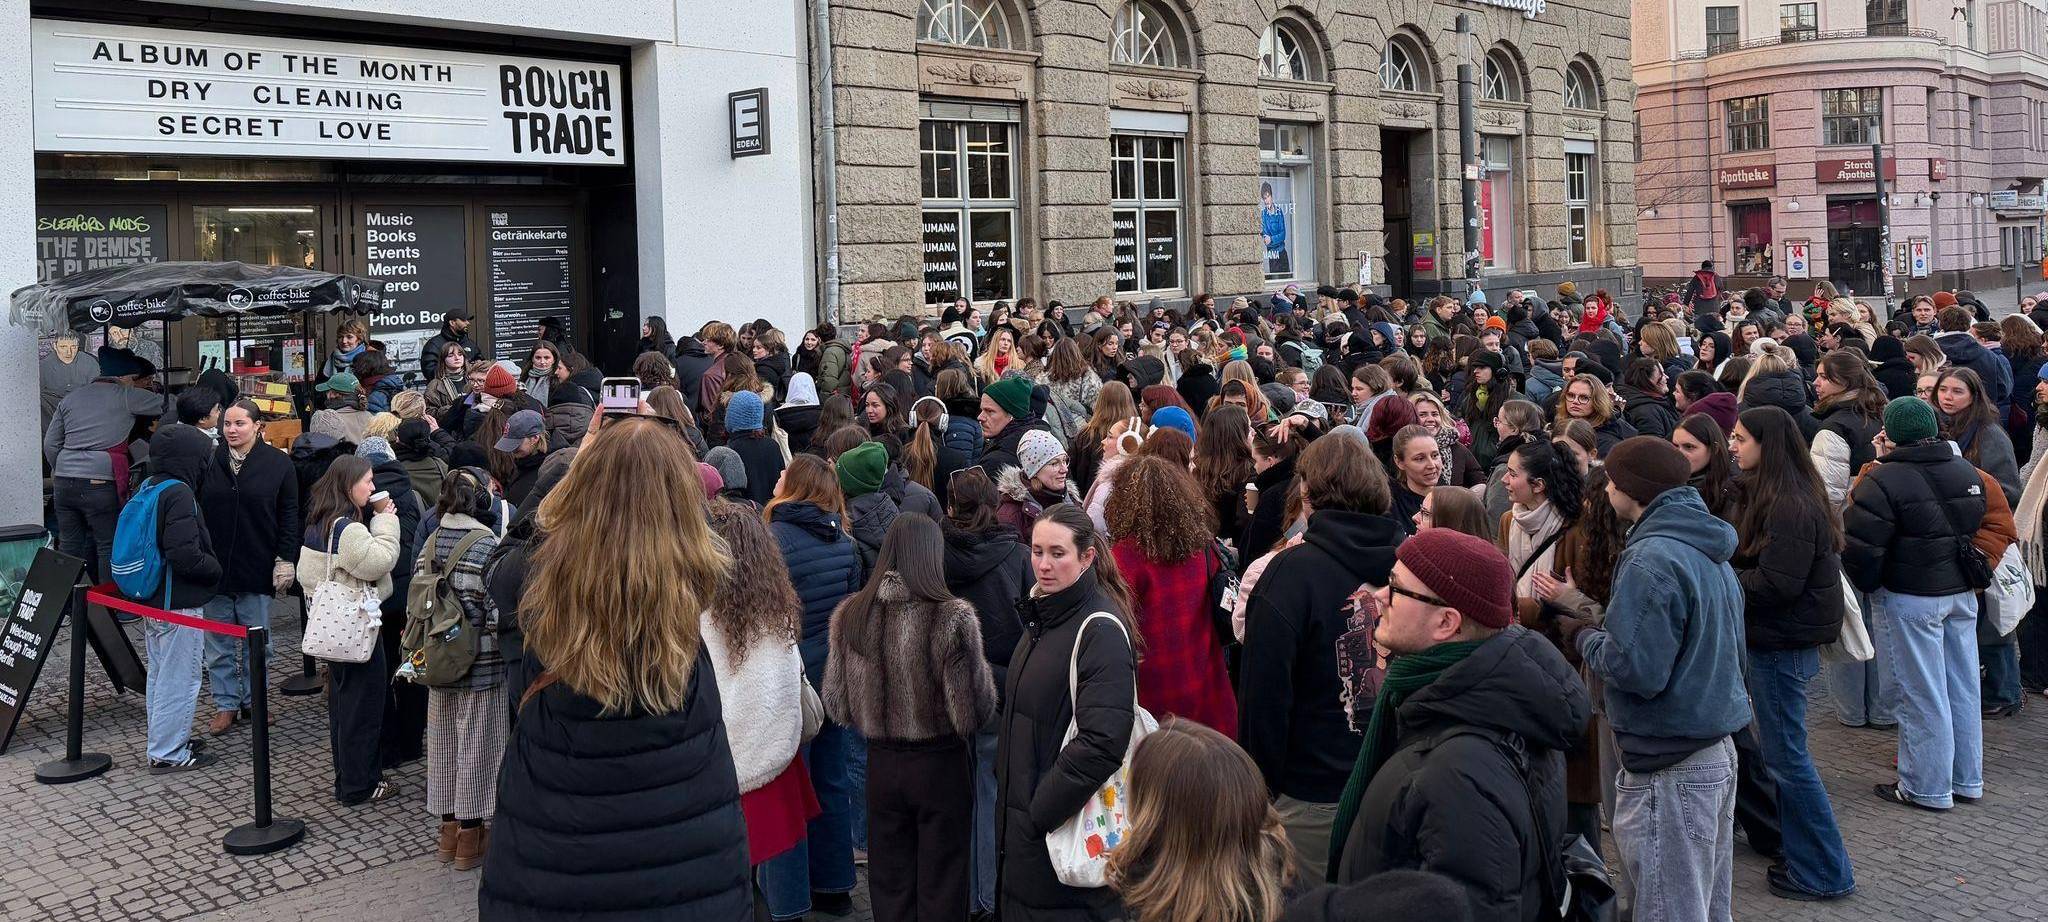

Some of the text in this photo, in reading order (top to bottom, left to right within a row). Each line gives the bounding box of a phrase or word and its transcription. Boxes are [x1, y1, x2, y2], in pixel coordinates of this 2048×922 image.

[92, 41, 452, 83] ALBUM OF THE MONTH
[500, 64, 612, 111] ROUGH
[148, 79, 402, 110] DRY CLEANING
[157, 115, 391, 141] SECRET LOVE
[503, 111, 616, 157] TRADE
[736, 139, 760, 149] EDEKA
[1844, 160, 1873, 170] Storch
[1720, 168, 1769, 185] Apotheke
[1836, 170, 1876, 180] Apothek
[37, 214, 150, 232] SLEAFORD MODS
[366, 212, 413, 226] Music
[1113, 220, 1134, 229] MANA
[922, 223, 956, 233] UMANA
[367, 229, 417, 243] Books
[492, 230, 567, 240] Getränkekarte
[37, 236, 151, 258] THE DEMISE
[923, 242, 957, 253] UMANA
[975, 241, 1007, 249] SECONDHAND
[1115, 237, 1135, 246] MANA
[367, 246, 420, 260] Events
[1114, 254, 1135, 263] MANA
[368, 262, 417, 276] Merch
[923, 262, 958, 272] UMANA
[977, 259, 1006, 268] Vintage
[1116, 271, 1136, 280] MANA
[384, 281, 420, 292] ereo
[924, 281, 958, 292] UMANA
[258, 288, 311, 300] coffee-bike
[117, 298, 167, 311] coffee-bike
[381, 298, 396, 309] ar
[369, 313, 415, 327] Photo
[9, 622, 42, 646] Welcome to
[3, 635, 38, 660] Rough Trade
